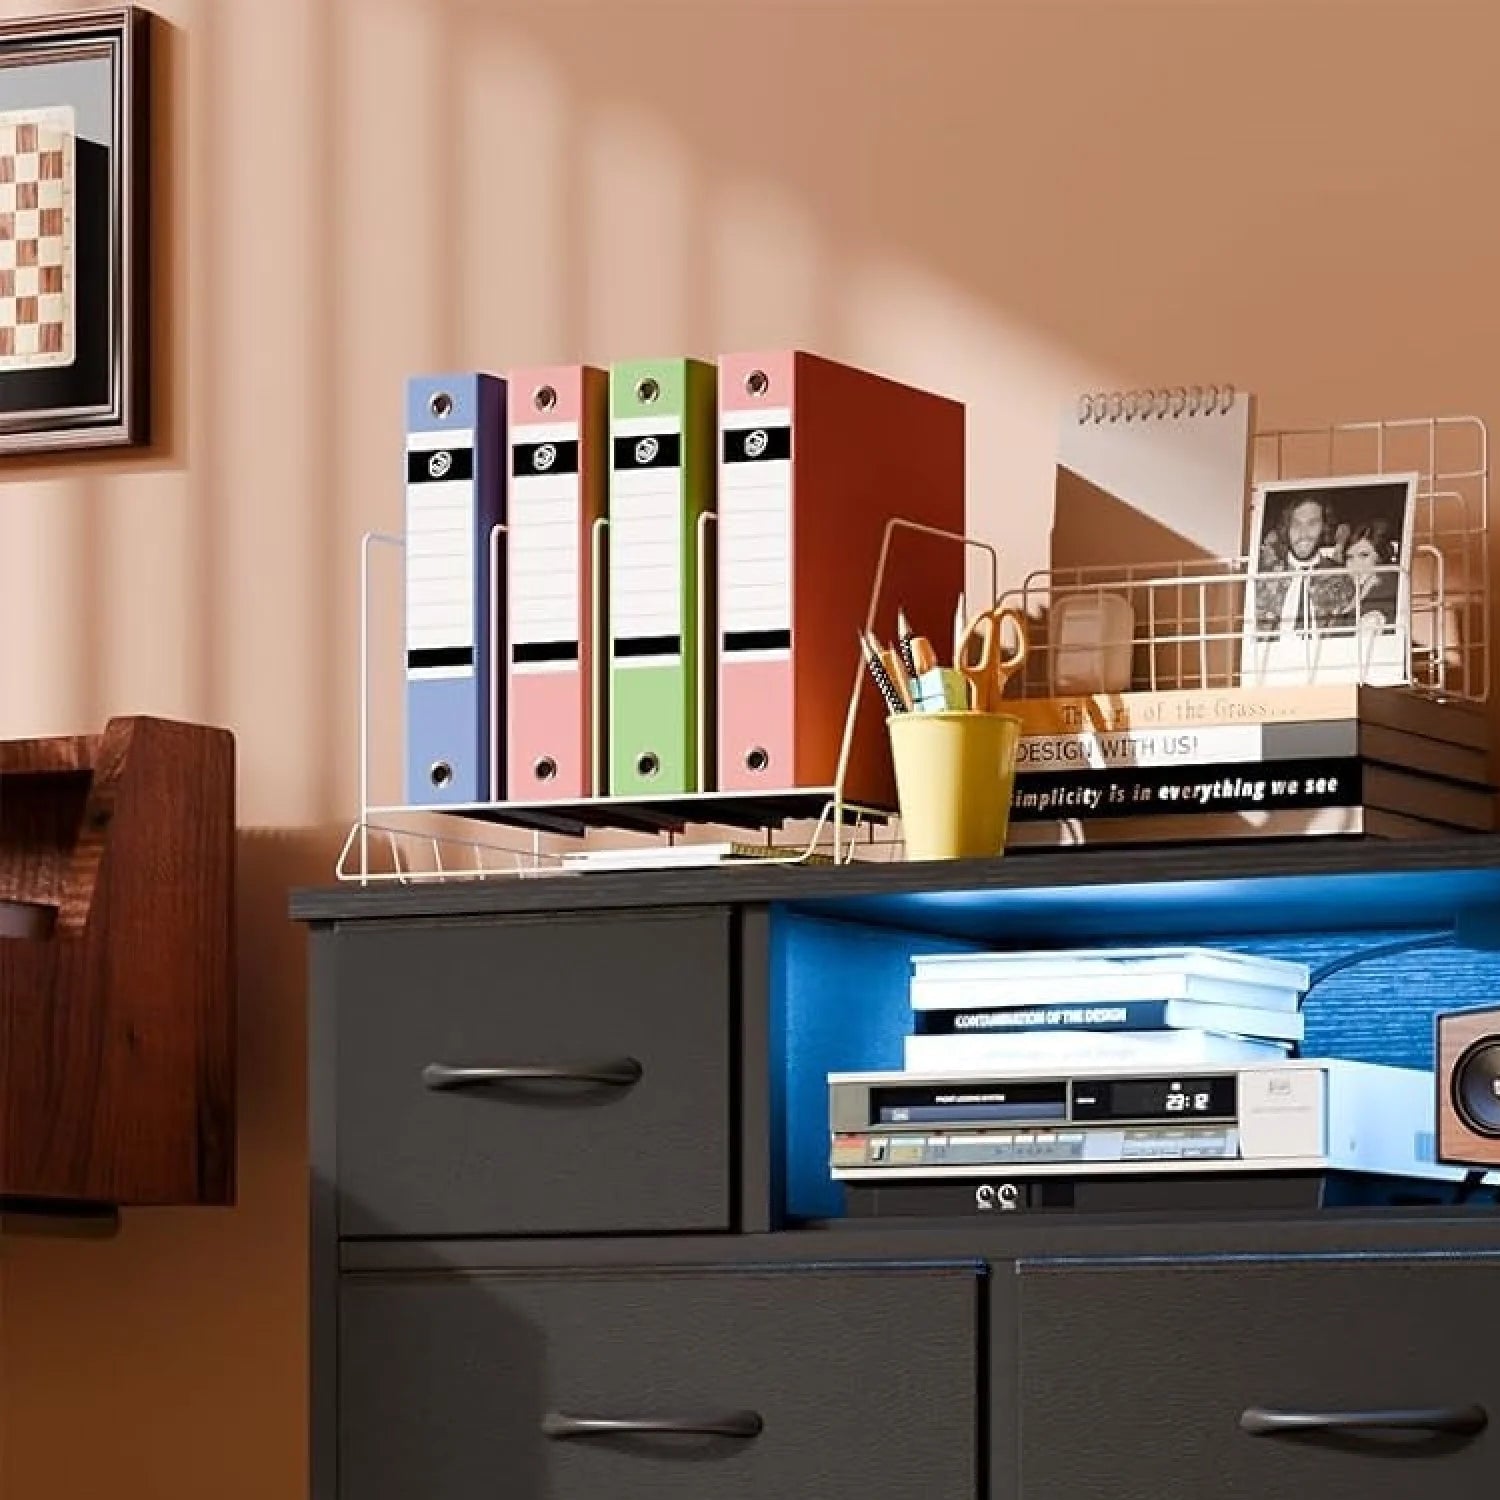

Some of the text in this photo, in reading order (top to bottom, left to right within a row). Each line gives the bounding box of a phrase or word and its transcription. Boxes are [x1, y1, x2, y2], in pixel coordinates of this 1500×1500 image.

[1101, 737, 1155, 759] WITH
[1164, 735, 1199, 755] US!
[1009, 777, 1338, 812] implicity is in everything we see
